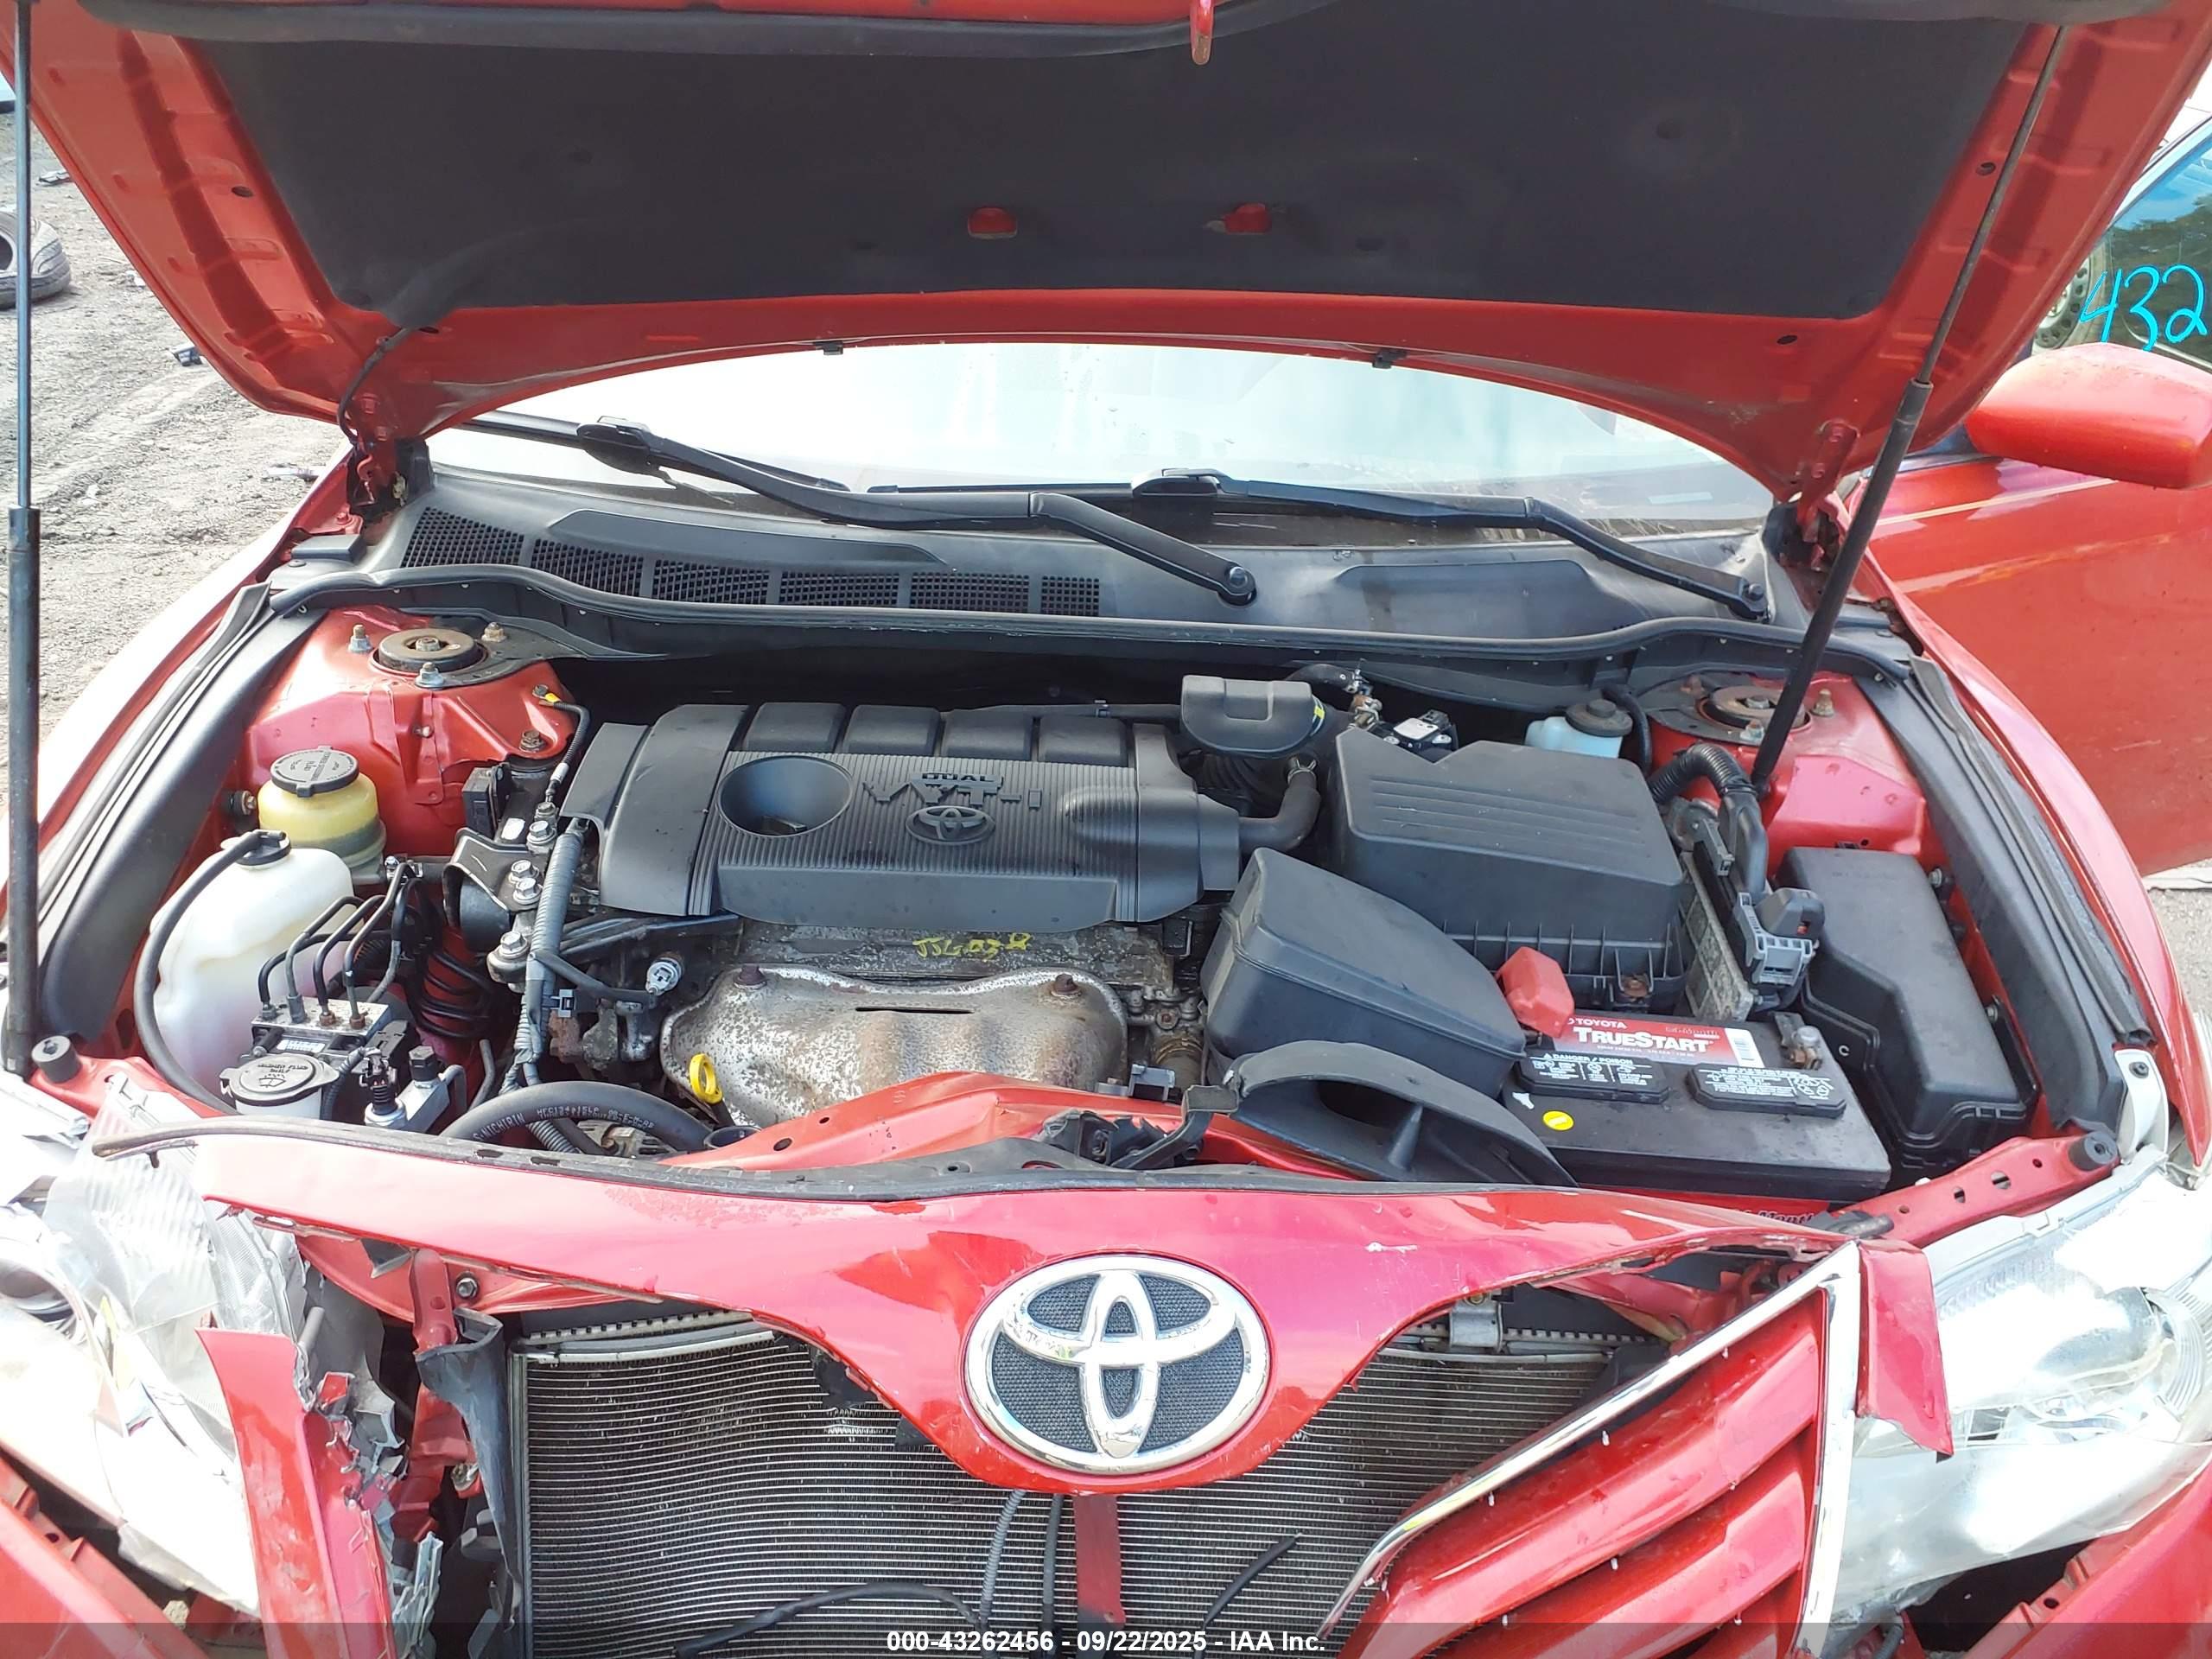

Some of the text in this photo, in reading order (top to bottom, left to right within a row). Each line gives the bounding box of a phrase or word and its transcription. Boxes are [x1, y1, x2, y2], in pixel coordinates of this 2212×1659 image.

[2080, 264, 2209, 353] 432
[922, 772, 995, 782] DUAL
[1575, 1018, 1628, 1029] TOYOTA
[1553, 1053, 1591, 1063] DANGER
[1599, 1057, 1634, 1065] POISON
